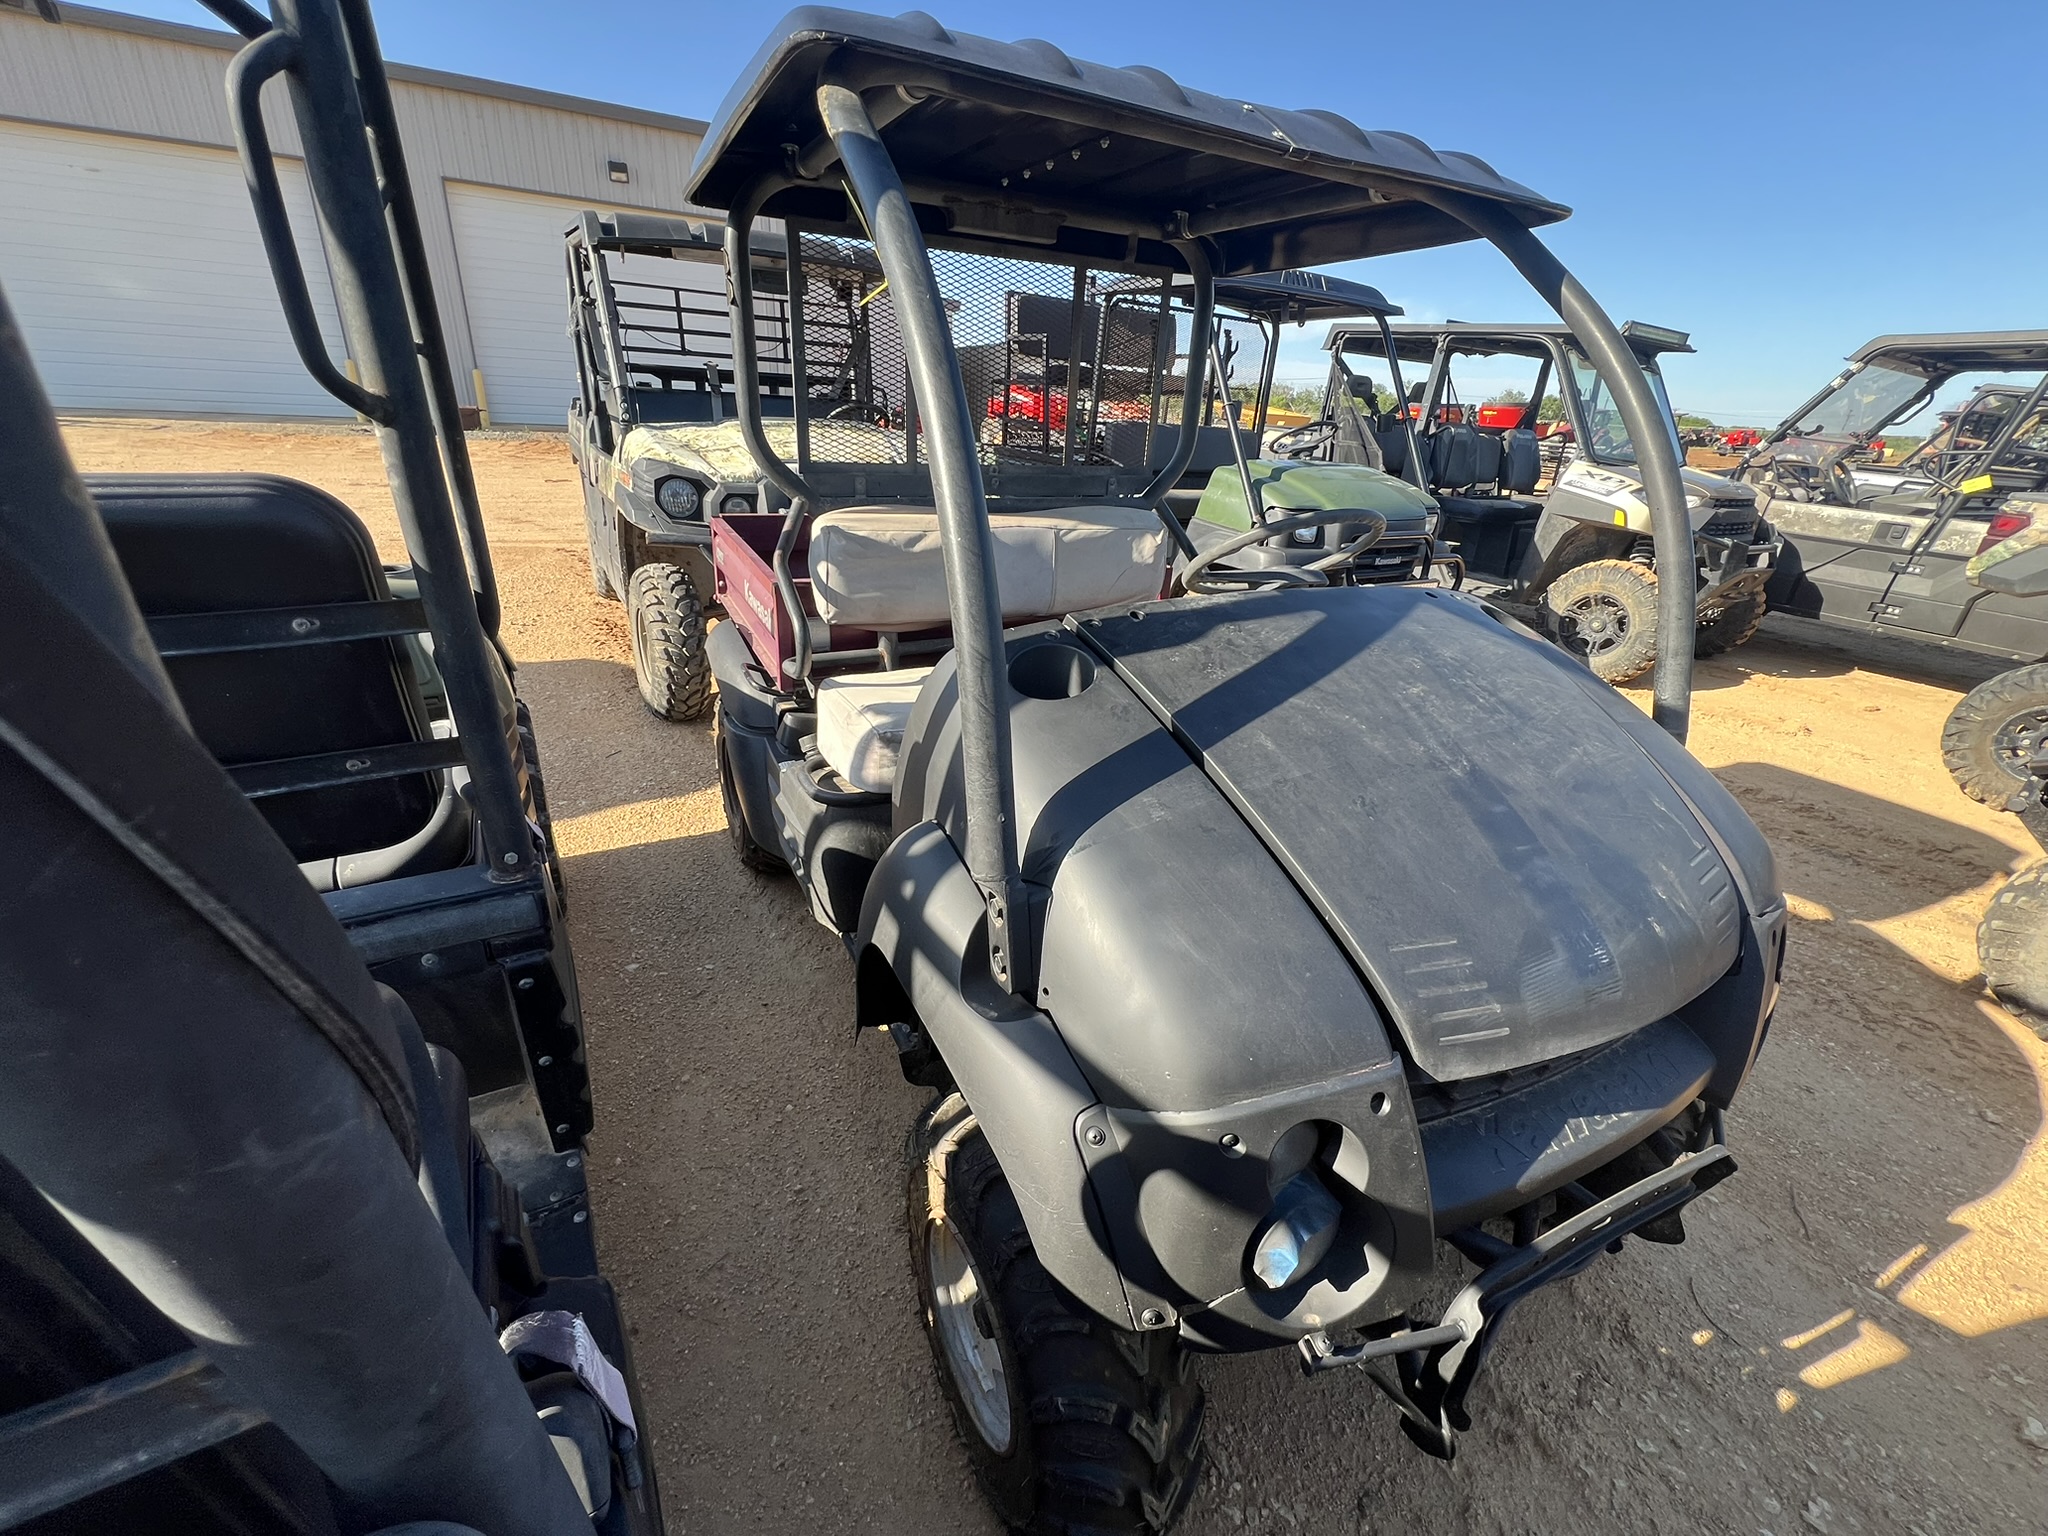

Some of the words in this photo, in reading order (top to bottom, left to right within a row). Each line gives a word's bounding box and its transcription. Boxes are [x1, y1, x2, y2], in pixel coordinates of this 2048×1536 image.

[1577, 469, 1627, 485] XP
[1374, 555, 1402, 566] Kawasaki
[743, 578, 772, 635] Kawasak
